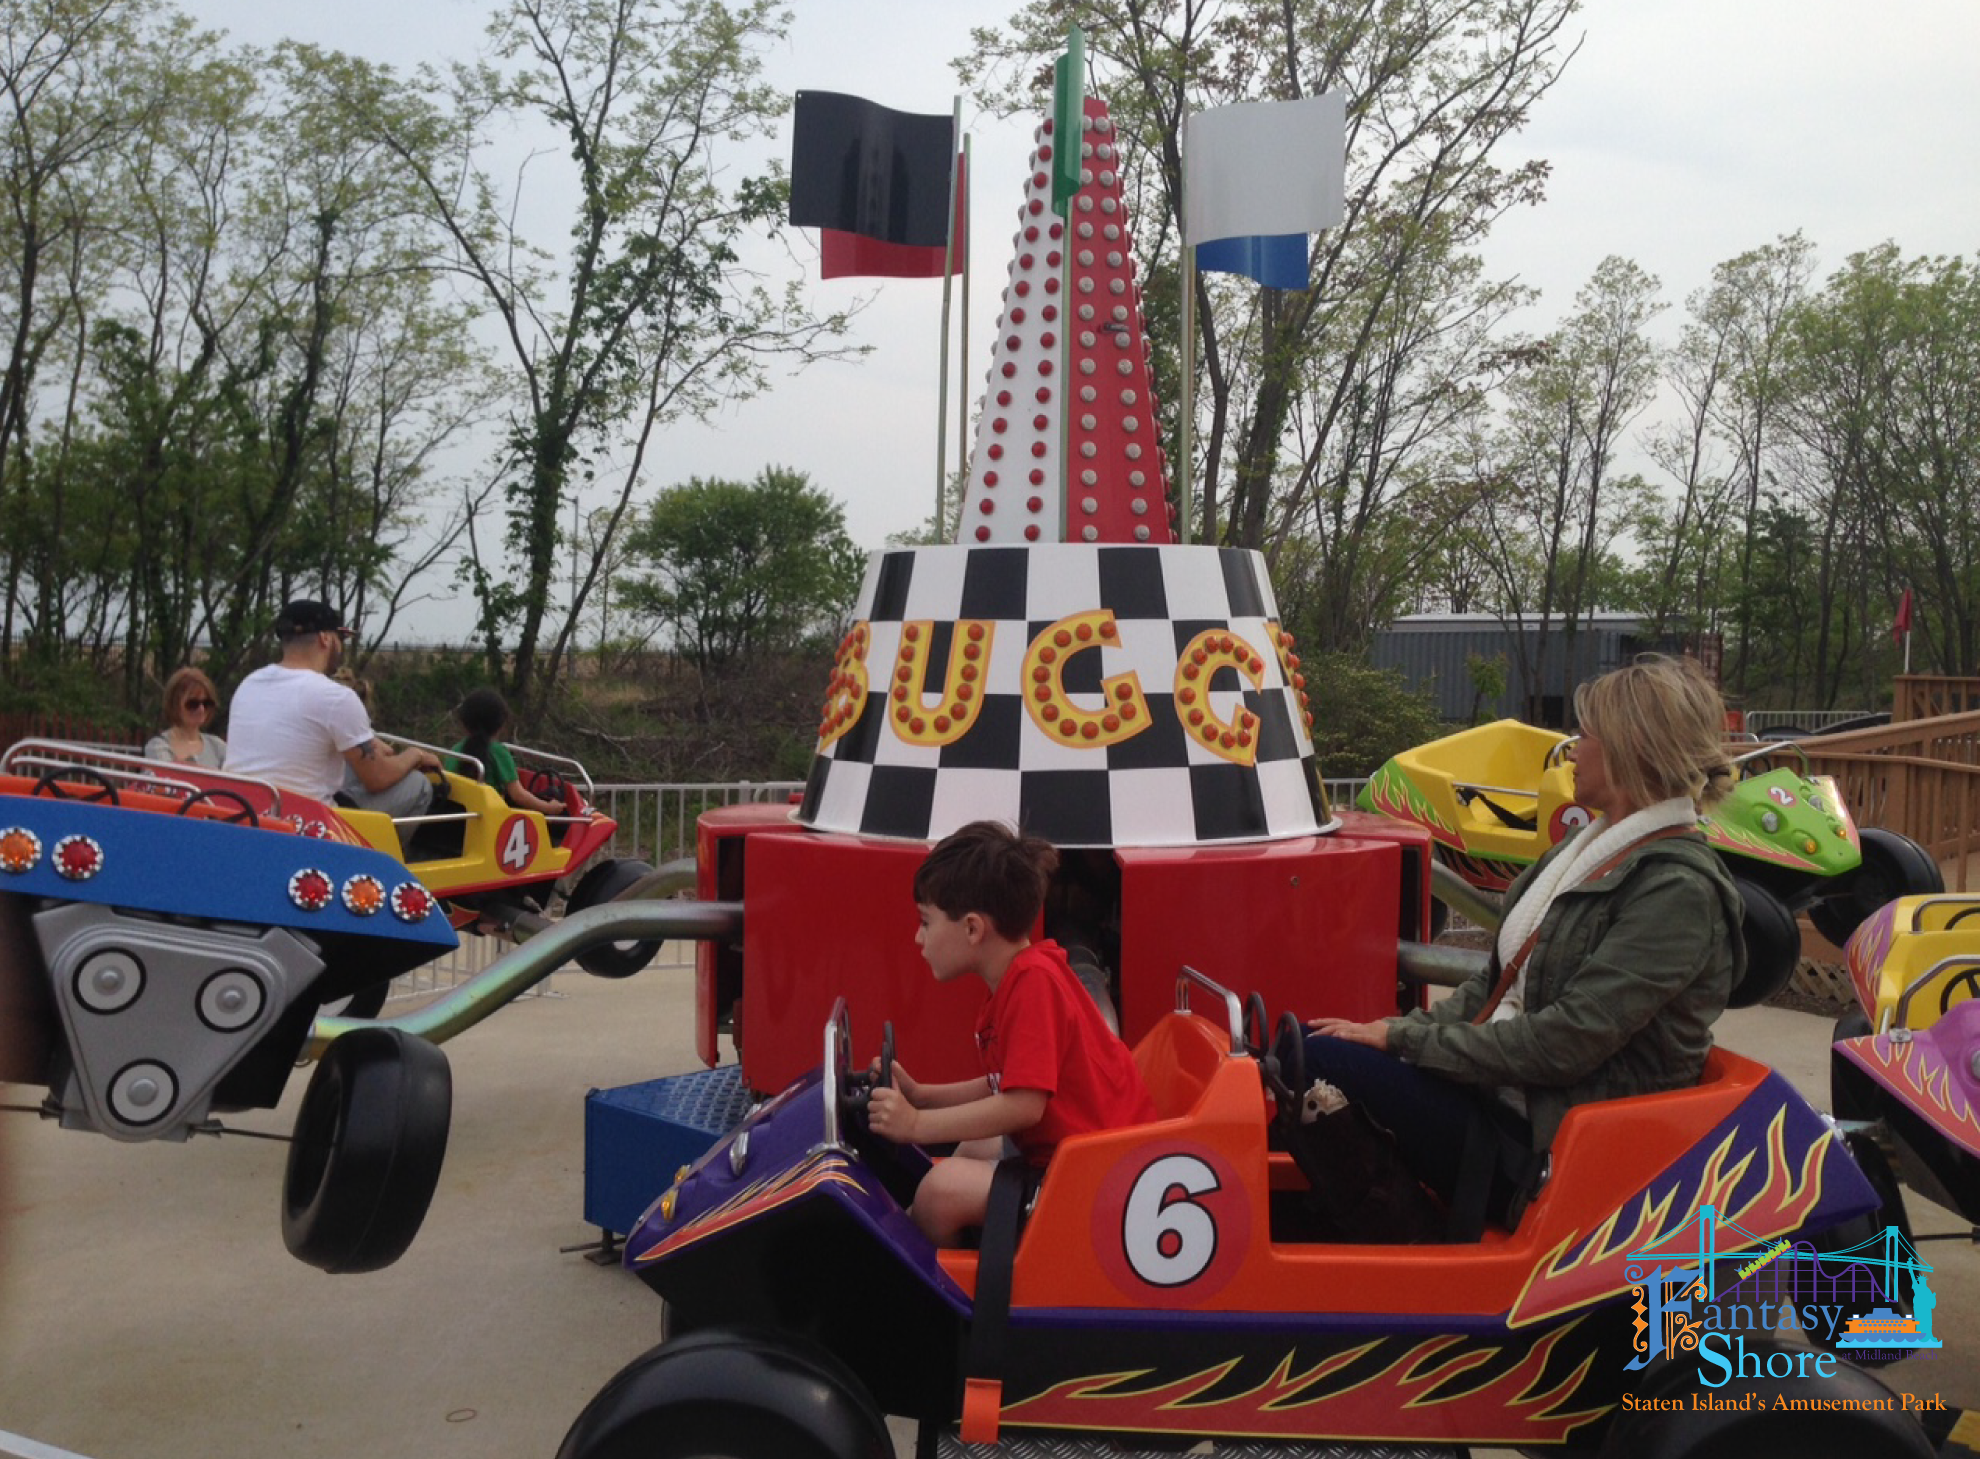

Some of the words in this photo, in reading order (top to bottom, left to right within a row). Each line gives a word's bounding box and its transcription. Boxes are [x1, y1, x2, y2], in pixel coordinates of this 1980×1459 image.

[818, 609, 1313, 767] BUGG
[1770, 786, 1794, 805] 2
[502, 818, 530, 869] 4
[1121, 1152, 1222, 1289] 6
